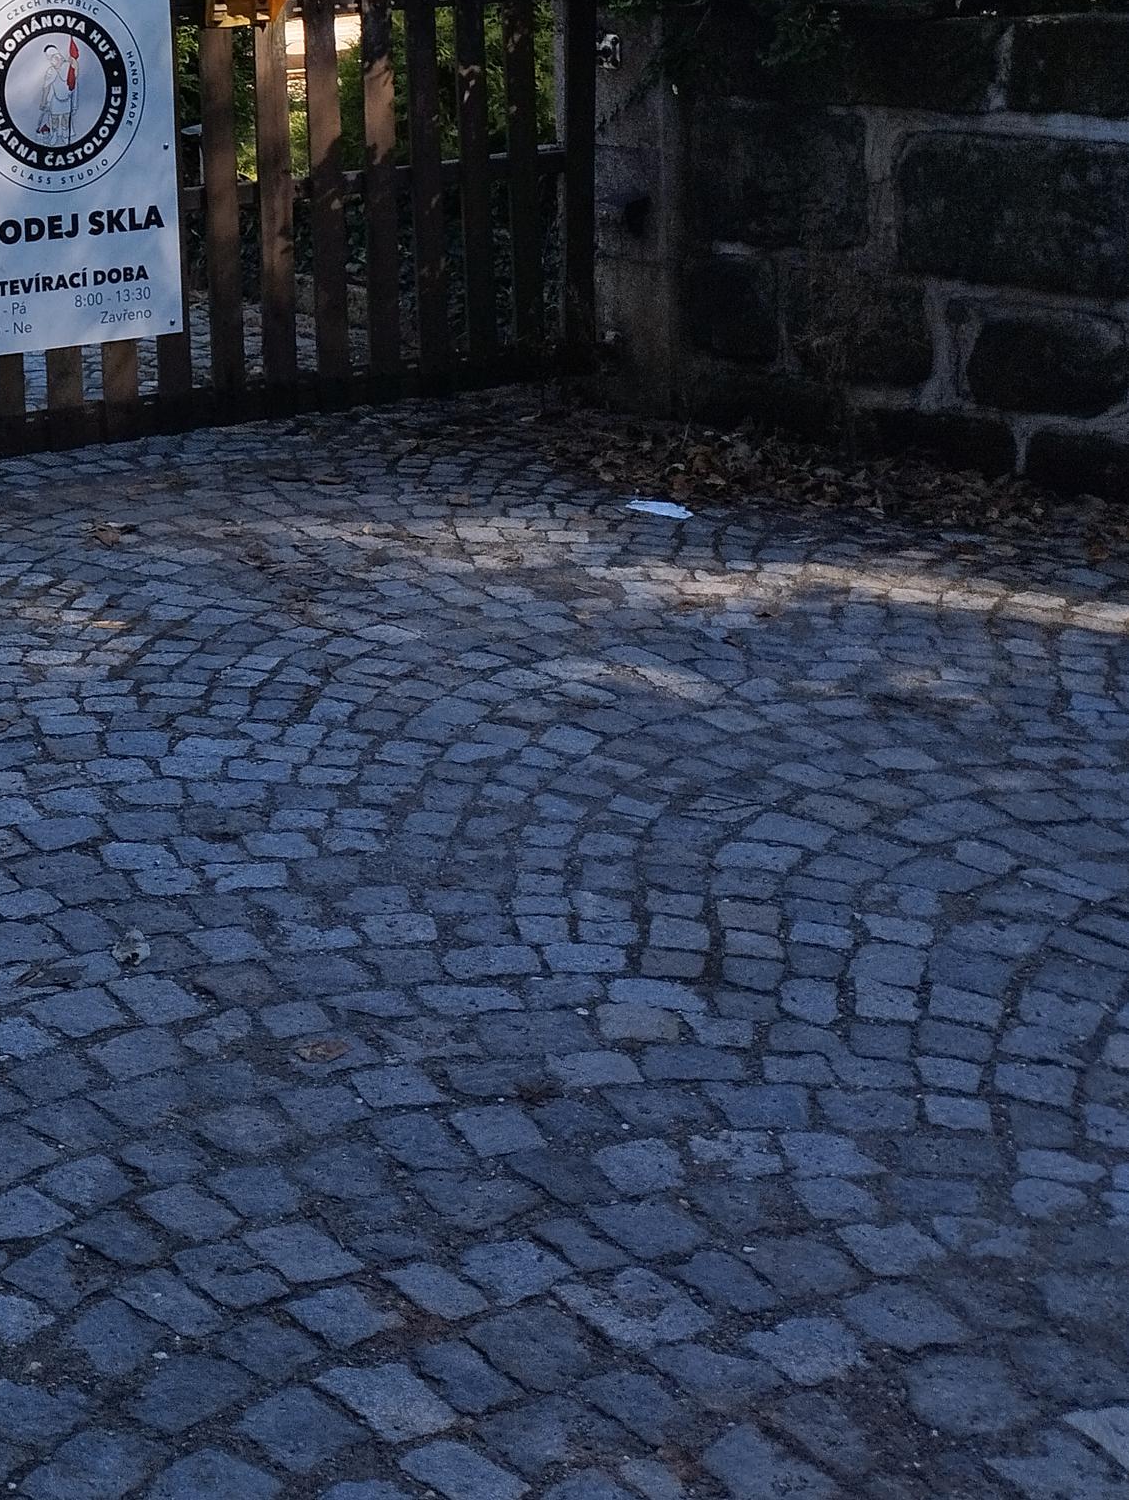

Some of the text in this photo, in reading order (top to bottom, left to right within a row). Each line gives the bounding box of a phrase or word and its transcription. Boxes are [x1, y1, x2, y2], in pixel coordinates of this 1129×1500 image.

[7, 0, 41, 21] CZECH
[89, 29, 118, 61] HUŤ
[126, 51, 139, 126] HAND MADE
[44, 86, 122, 166] ČASTOLOVICE
[11, 158, 108, 185] GLASS STUDIO
[88, 205, 165, 235] SKLA
[93, 265, 149, 285] DOBA
[12, 301, 27, 315] Pá
[74, 292, 103, 308] 8:00
[116, 286, 151, 302] 13:30
[100, 308, 152, 324] Zavřeno
[13, 321, 33, 334] Ne
